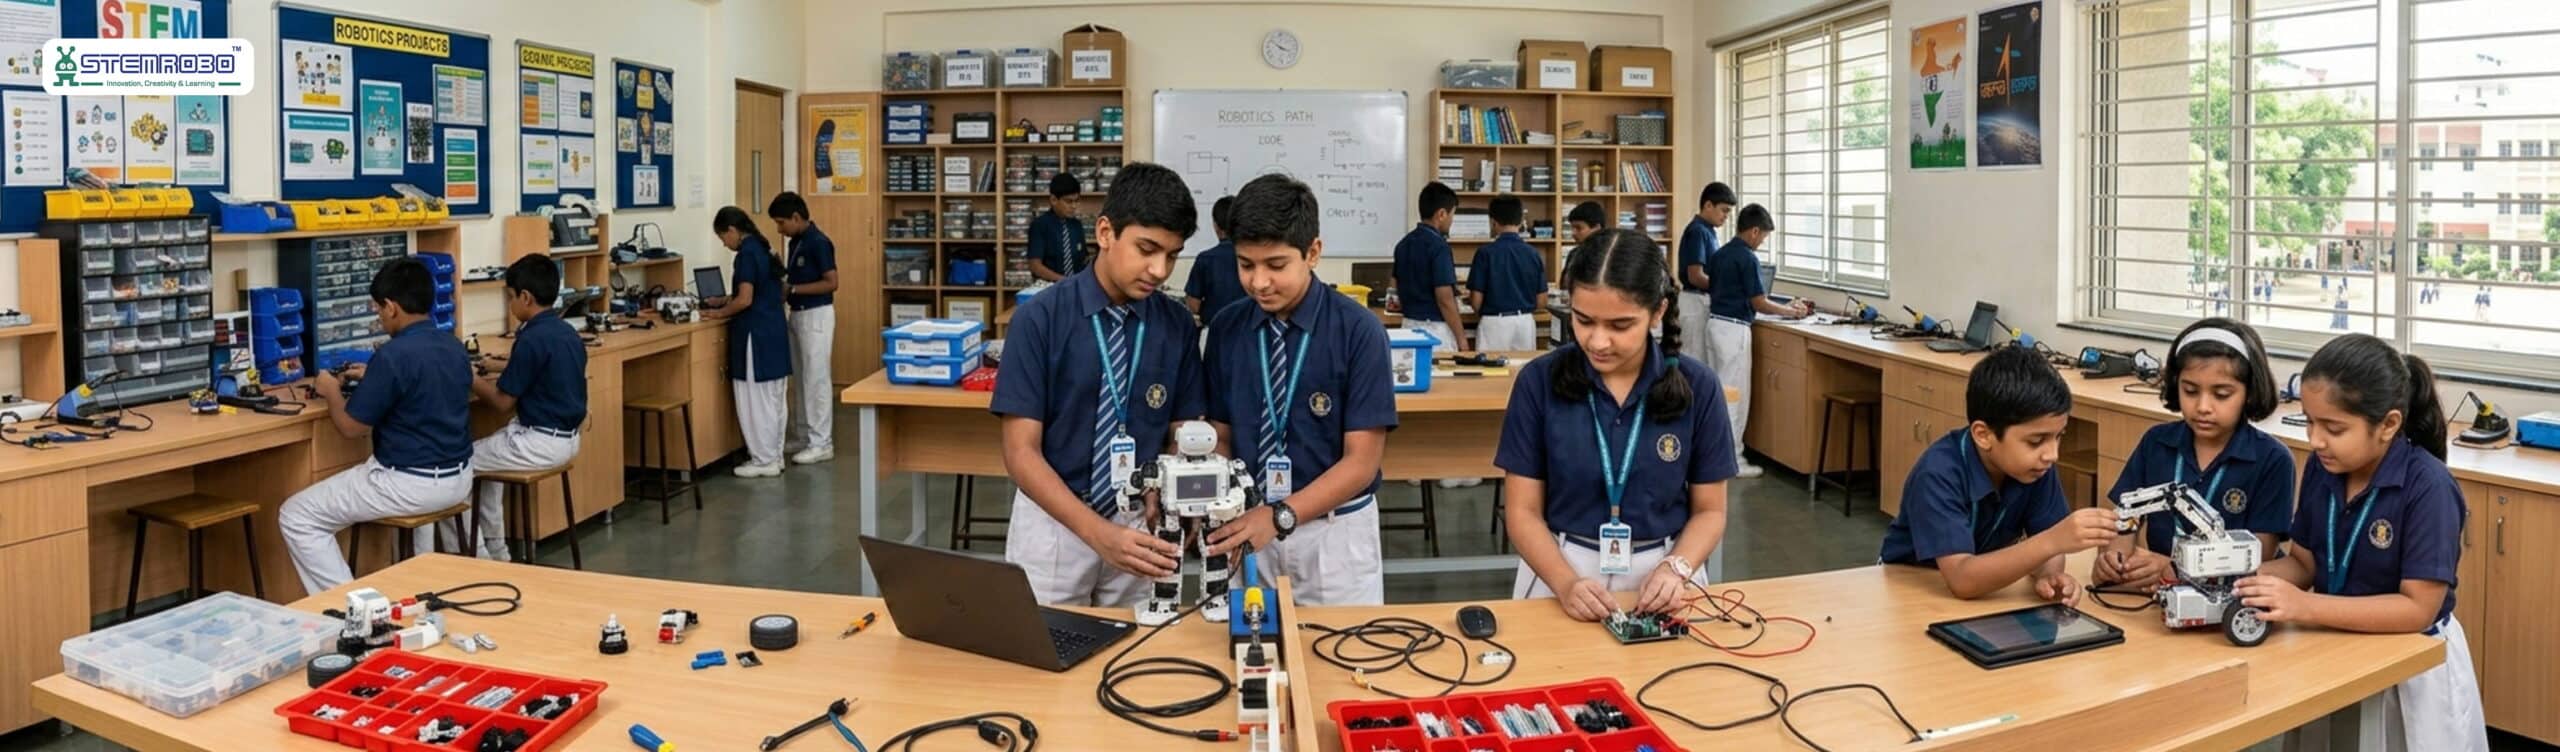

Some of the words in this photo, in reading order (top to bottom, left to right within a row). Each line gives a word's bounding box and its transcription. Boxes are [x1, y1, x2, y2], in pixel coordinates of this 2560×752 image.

[336, 23, 394, 45] ROBOTICS
[1218, 110, 1275, 123] ROBOTICS
[1285, 110, 1314, 122] PATH
